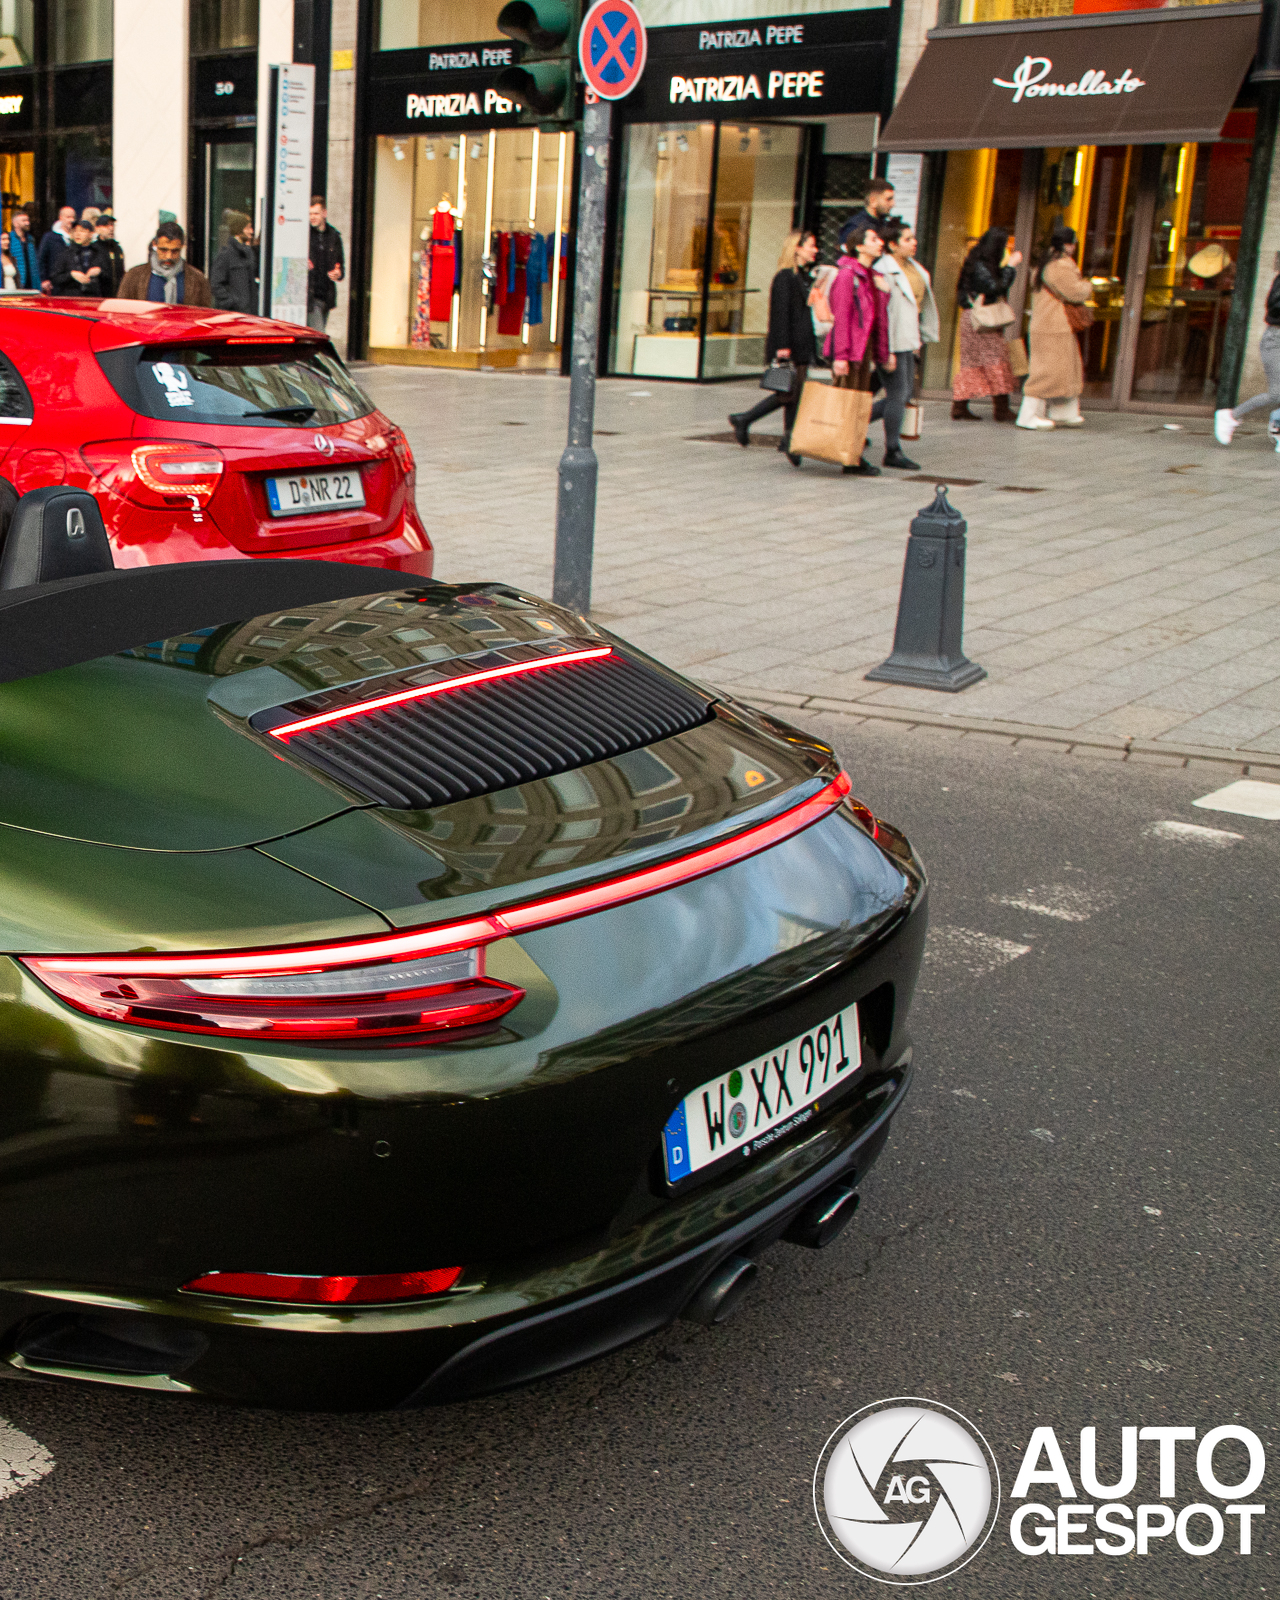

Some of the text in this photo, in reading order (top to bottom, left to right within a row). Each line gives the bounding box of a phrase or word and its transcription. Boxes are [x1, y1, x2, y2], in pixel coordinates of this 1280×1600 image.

[699, 24, 804, 50] PATRIZIA PEPE
[429, 48, 513, 70] PATRIZIA PEPE
[215, 81, 234, 95] 50
[670, 70, 825, 104] PATRIZIA PEPE
[992, 55, 1146, 103] Pomellato
[406, 92, 481, 119] PATRIZIA
[288, 475, 353, 504] D NR 22
[702, 1082, 725, 1151] W
[750, 1048, 793, 1127] XX
[798, 1012, 849, 1095] 991
[672, 1145, 684, 1165] D
